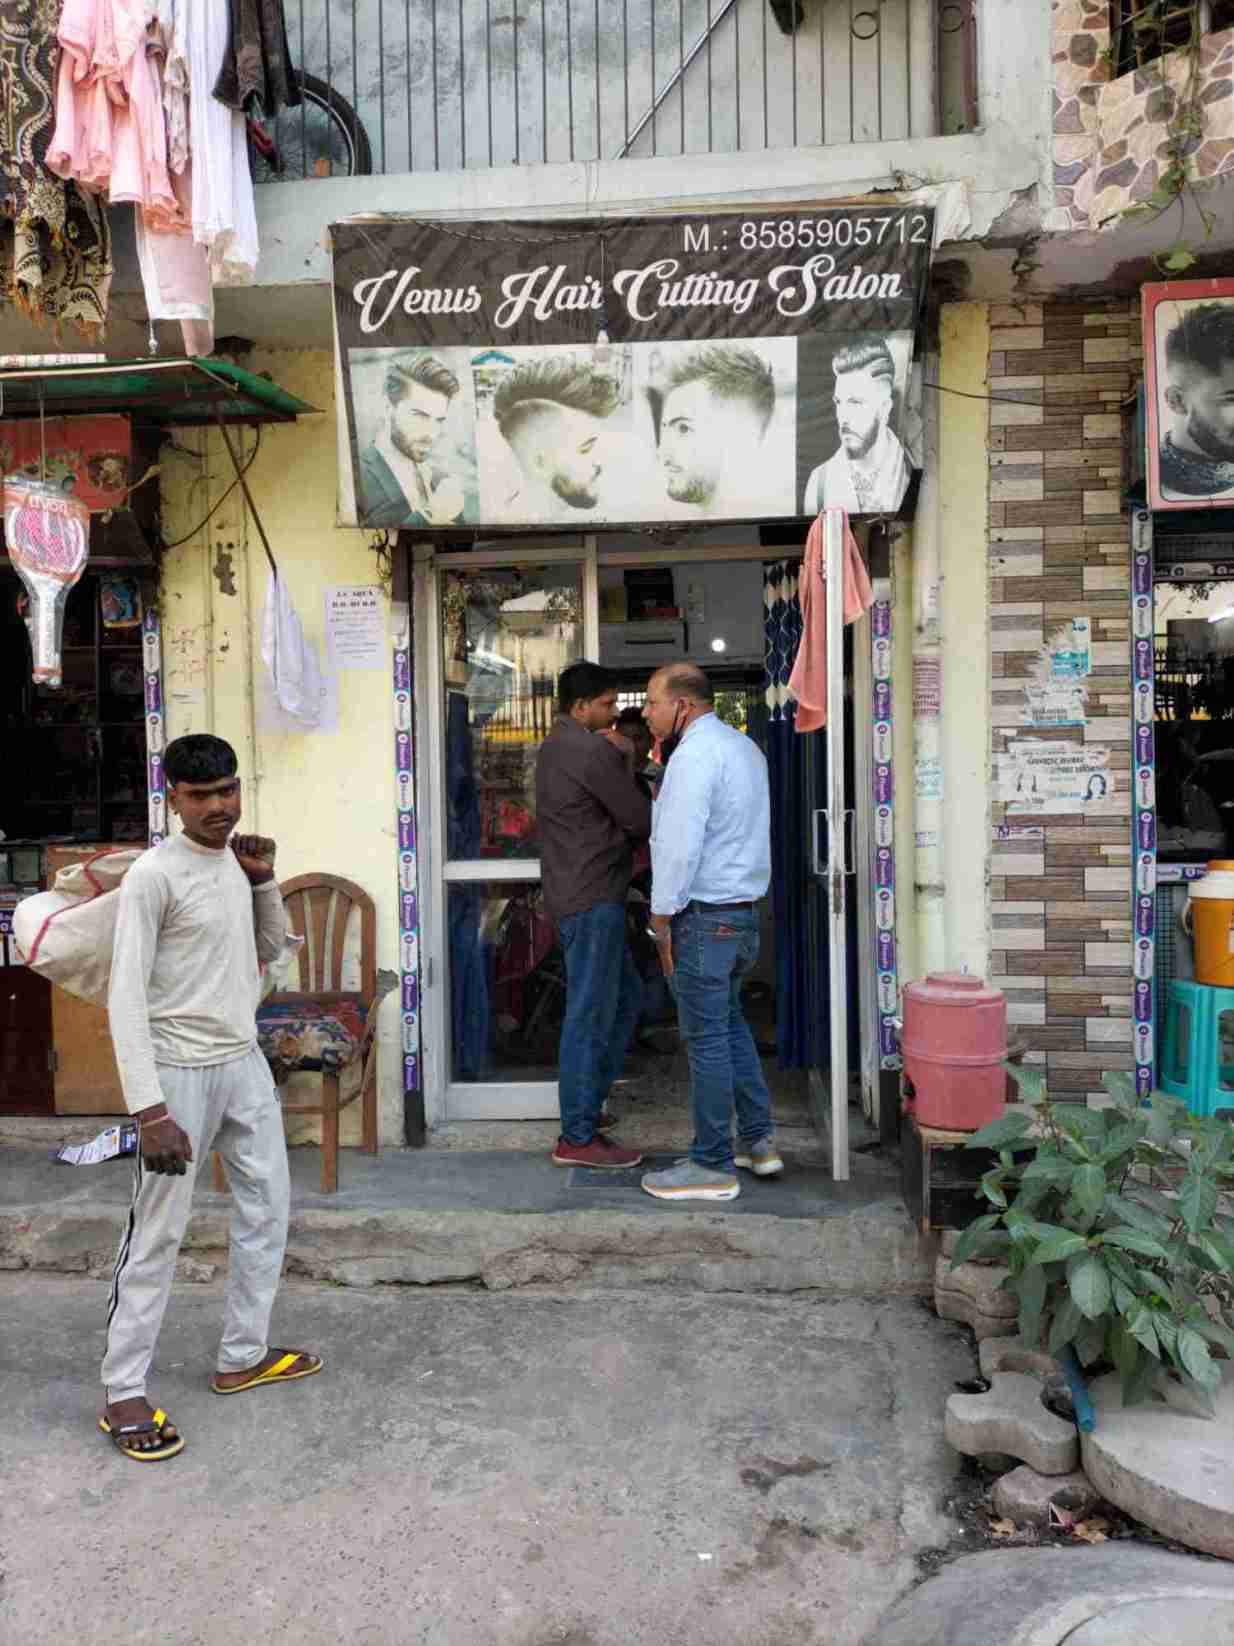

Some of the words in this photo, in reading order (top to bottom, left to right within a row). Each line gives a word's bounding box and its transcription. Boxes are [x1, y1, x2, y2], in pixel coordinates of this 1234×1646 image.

[684, 223, 728, 252] M.:
[740, 215, 927, 250] 8585905712
[353, 266, 481, 333] Venus
[494, 264, 603, 329] Hair
[612, 258, 760, 322] Cutting
[767, 253, 902, 317] Salon
